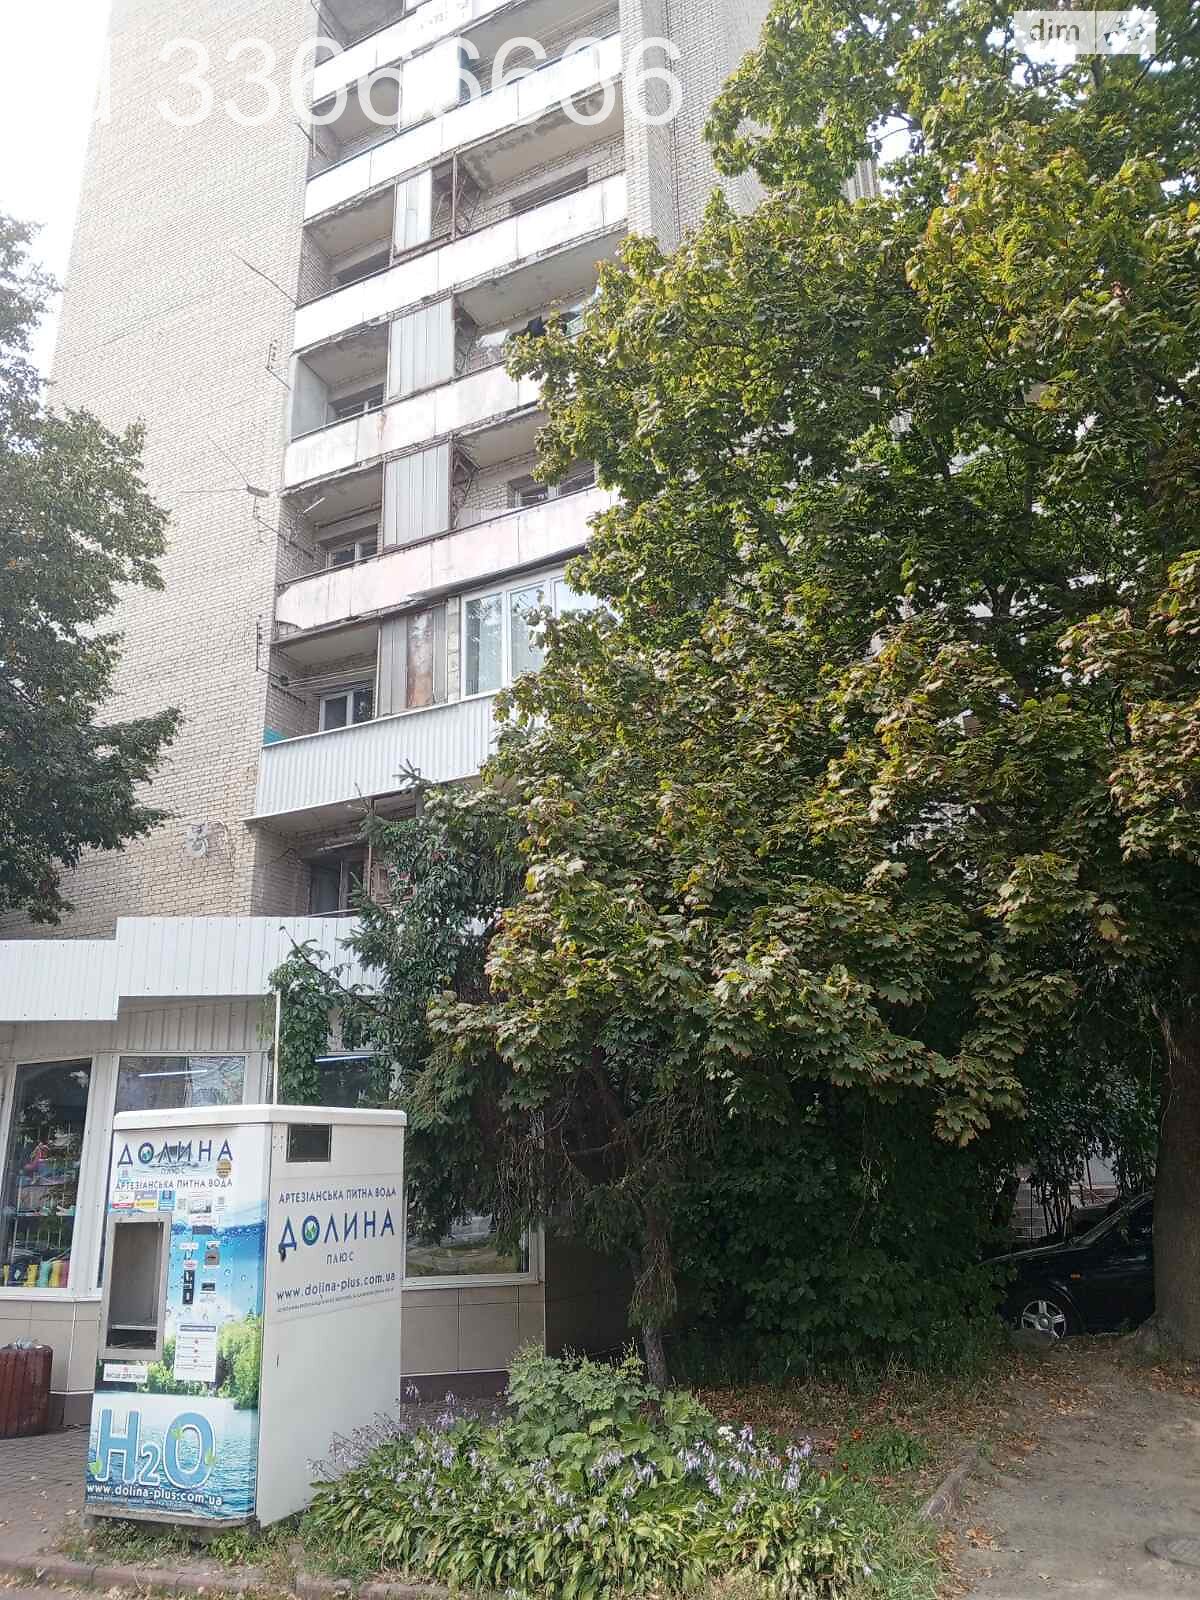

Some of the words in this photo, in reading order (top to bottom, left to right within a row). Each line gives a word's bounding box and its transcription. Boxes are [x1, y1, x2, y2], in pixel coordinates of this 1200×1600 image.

[117, 1138, 234, 1168] ДОЛИНА
[115, 1178, 175, 1192] АРТЕЗІАНСЬКА
[176, 1178, 206, 1190] ПИТНА
[207, 1177, 234, 1188] ВОДА
[278, 1188, 345, 1205] АРТЕЗІАНСЬКА
[346, 1187, 376, 1200] ПИТНА
[375, 1185, 398, 1198] ВОДА
[278, 1208, 396, 1252] ДОЛИНА
[326, 1250, 355, 1265] ПЛЮС
[275, 1271, 396, 1301] www.dolina-plus.com.ua
[95, 1407, 217, 1490] H2O
[86, 1483, 223, 1506] www.dolina-plus.com.ua
